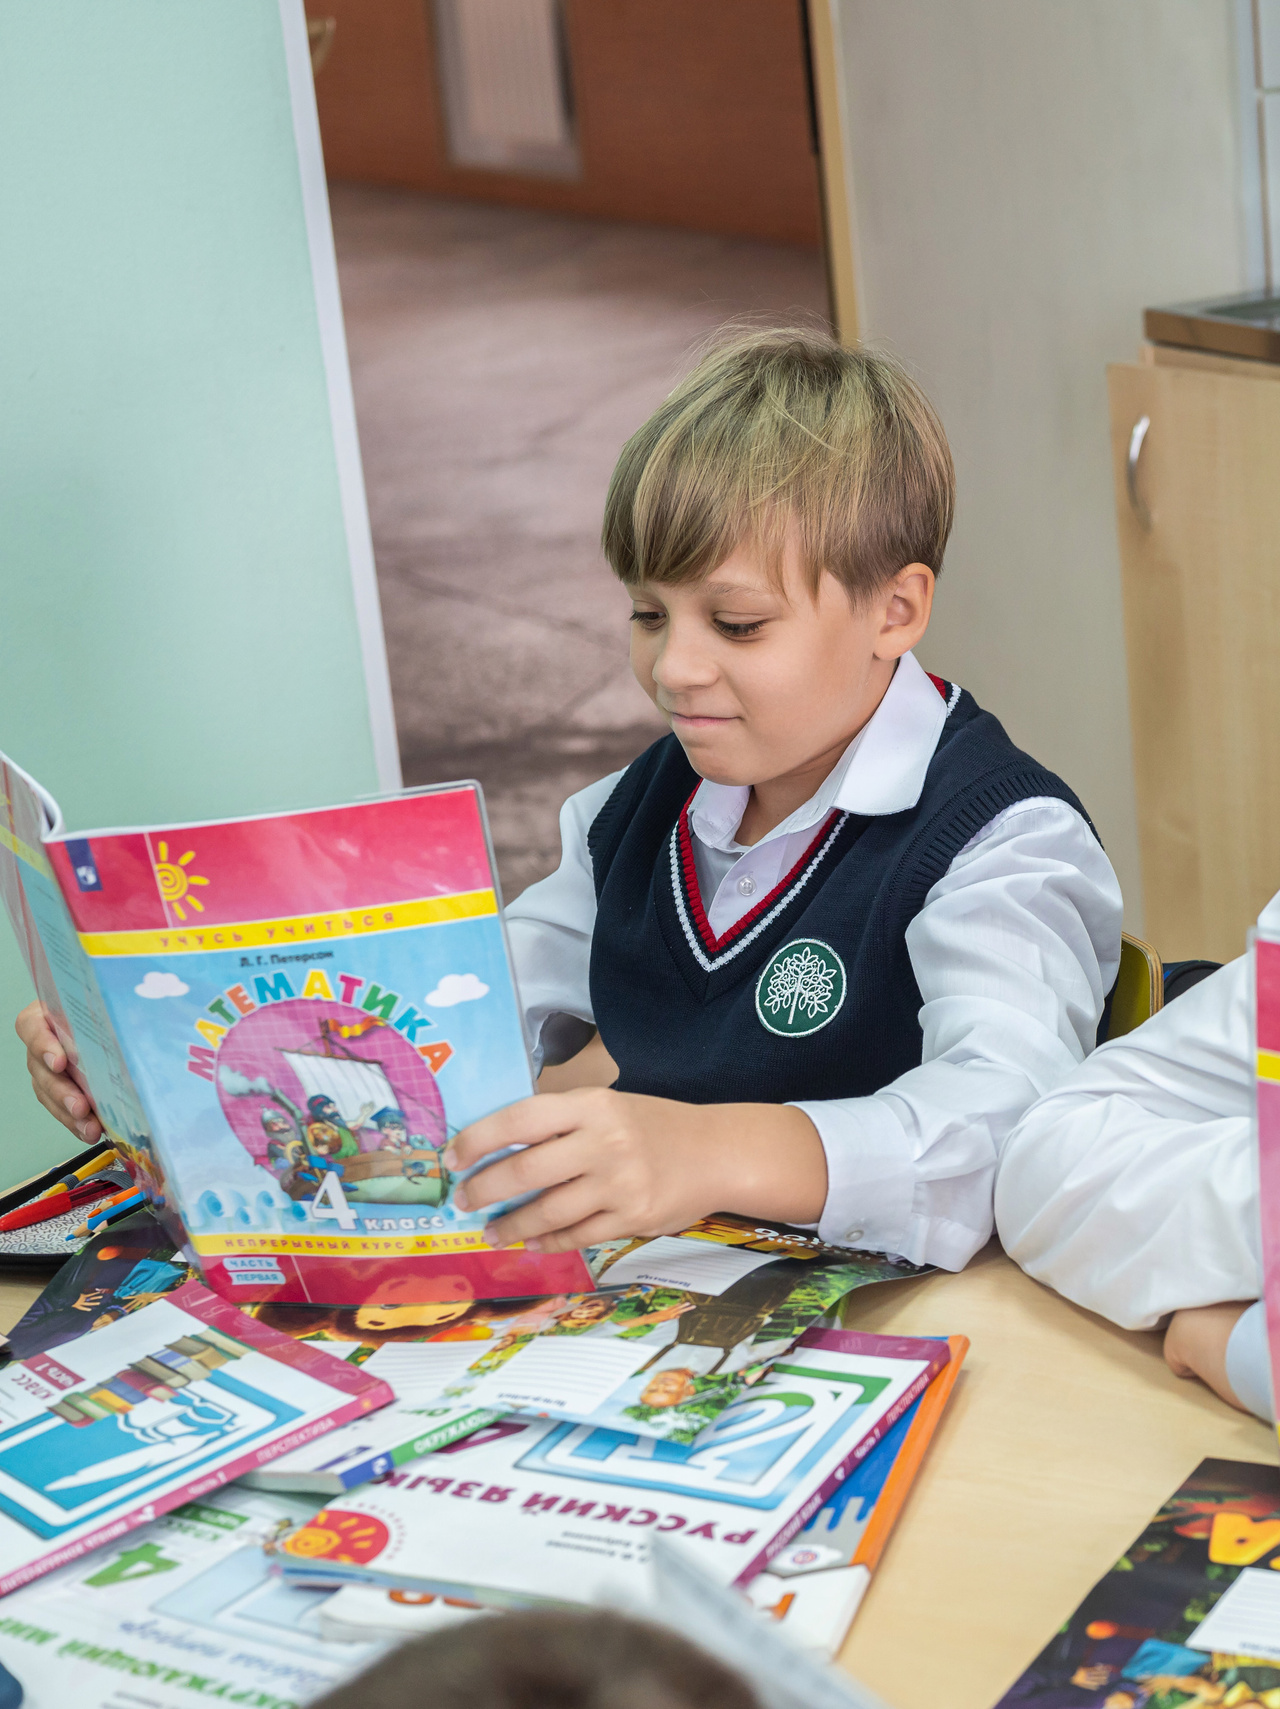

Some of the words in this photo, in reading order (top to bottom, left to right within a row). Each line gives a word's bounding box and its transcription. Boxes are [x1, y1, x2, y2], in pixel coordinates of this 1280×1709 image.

[159, 931, 243, 948] УЧУСЬ
[266, 912, 395, 939] УЧИТЬСЯ
[270, 951, 334, 965] Петерсон
[187, 968, 456, 1083] МАТЕМАТИКА
[310, 1170, 359, 1232] 4
[363, 1213, 445, 1232] класс
[224, 1237, 351, 1250] НЕПРЕРЫВНЫЙ
[361, 1239, 405, 1250] КУРС
[415, 1236, 485, 1249] МАТЕМ
[229, 1258, 274, 1269] ЧАСТЬ
[236, 1272, 279, 1282] ПЕРВАЯ
[255, 1416, 336, 1463] ПЕРСПЕКТИВА
[413, 1409, 501, 1454] ОКРУЖАЮЩ
[520, 1491, 759, 1545] РУССКИЙ
[82, 1541, 182, 1589] 4
